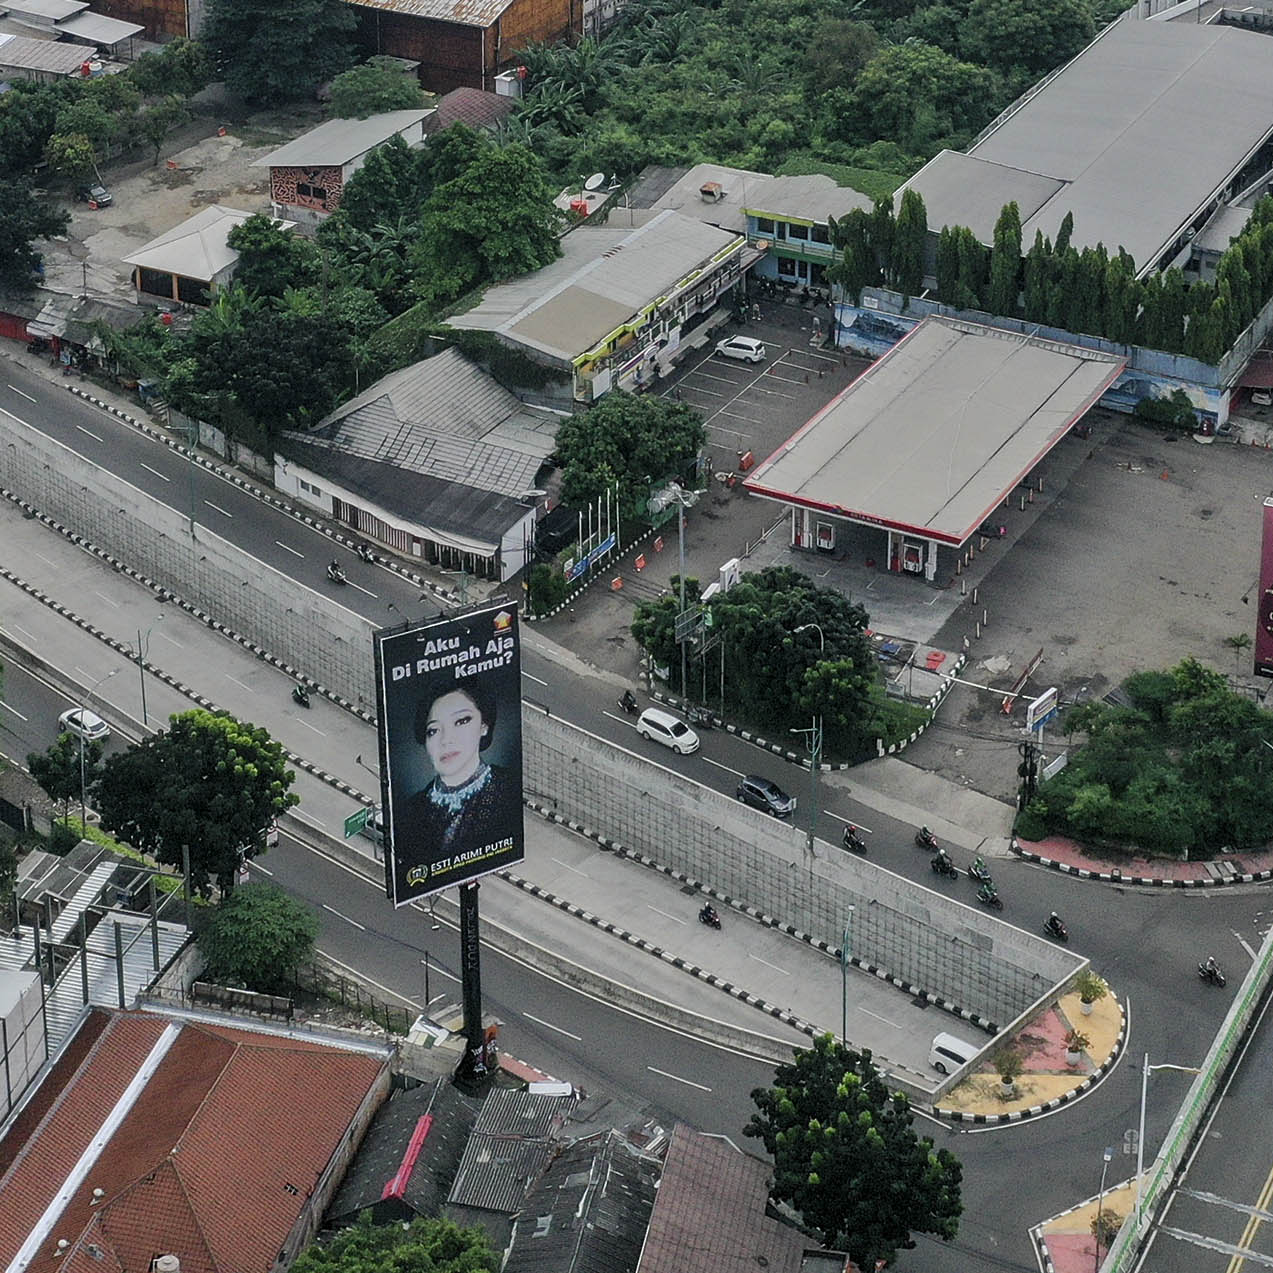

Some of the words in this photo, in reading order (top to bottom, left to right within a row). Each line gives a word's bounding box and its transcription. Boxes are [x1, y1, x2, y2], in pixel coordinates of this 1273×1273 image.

[392, 663, 411, 681] Di
[416, 646, 480, 674] Rumah
[485, 636, 514, 655] Aja
[424, 636, 460, 656] Aku
[455, 651, 513, 679] Kamu?
[431, 858, 450, 872] ESTI
[453, 848, 482, 865] ARIMI
[485, 836, 513, 853] PUTRI
